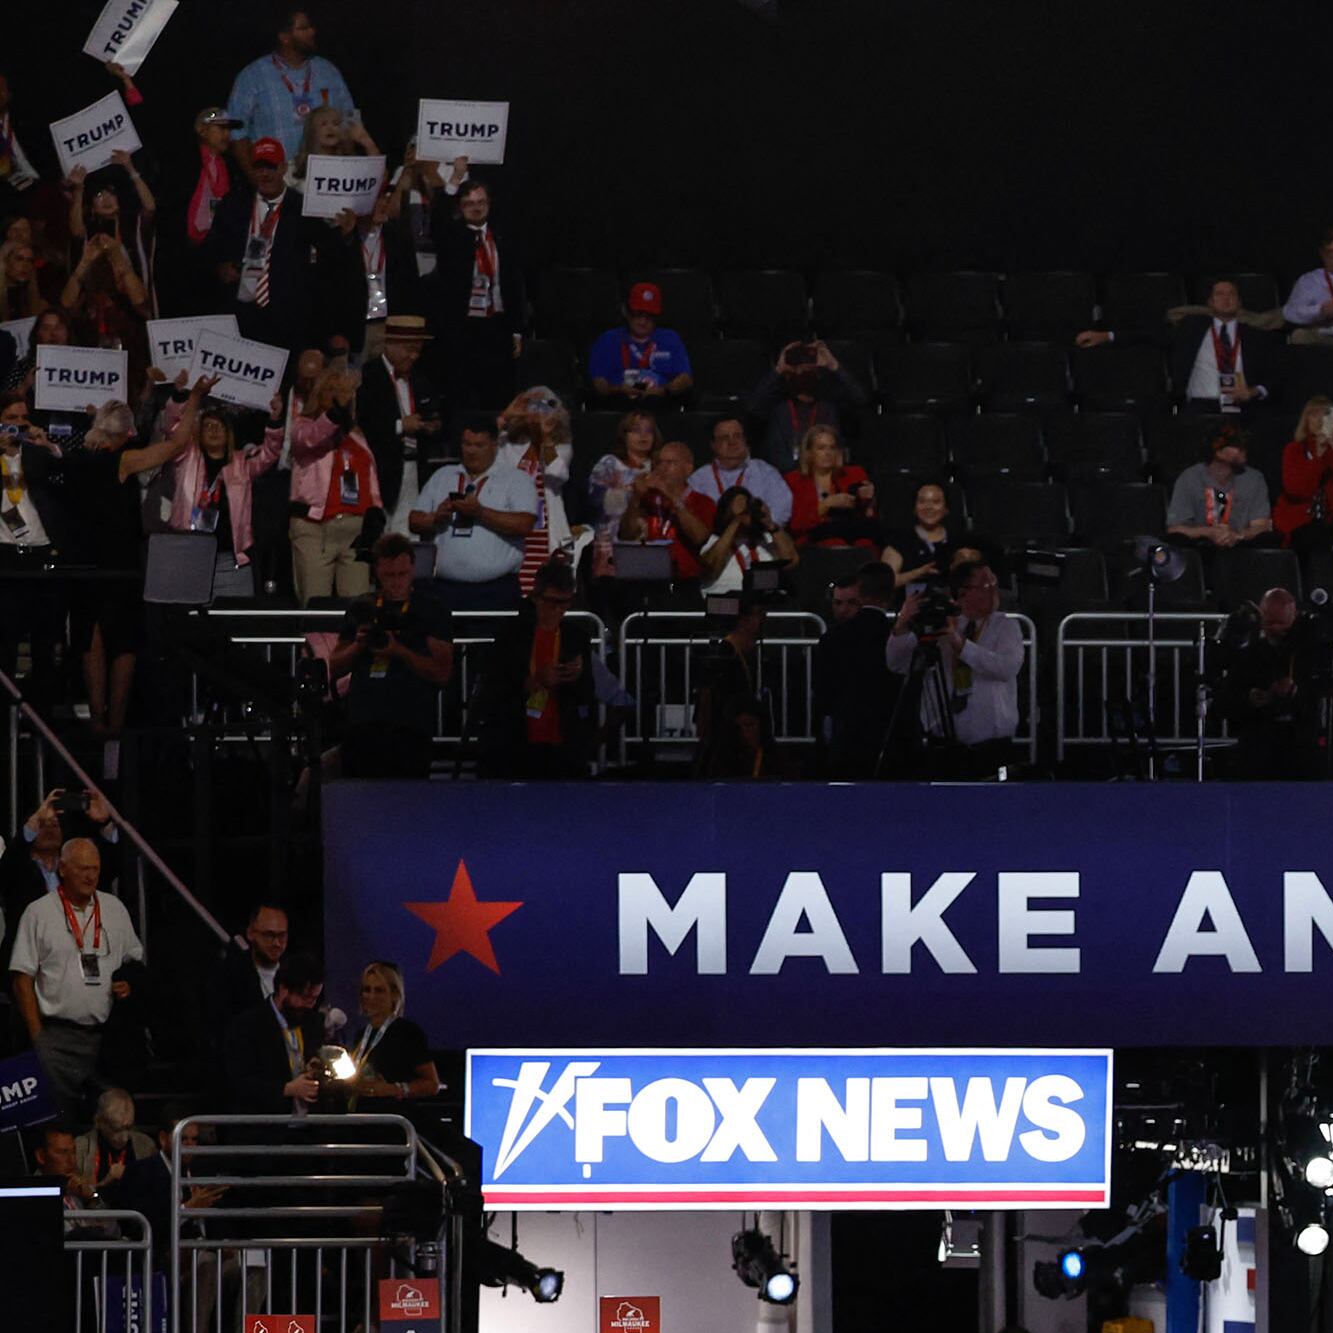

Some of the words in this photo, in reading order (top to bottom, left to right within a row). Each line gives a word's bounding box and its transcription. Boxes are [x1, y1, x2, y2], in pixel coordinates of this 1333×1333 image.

[64, 112, 127, 154] TRUMP
[426, 120, 500, 138] TRUMP
[314, 175, 377, 193] TRUMP
[44, 366, 120, 386] TRUMP
[199, 349, 276, 383] TRUMP
[619, 869, 1081, 975] MAKE
[575, 1077, 777, 1164] FOX
[796, 1074, 1086, 1163] NEWS
